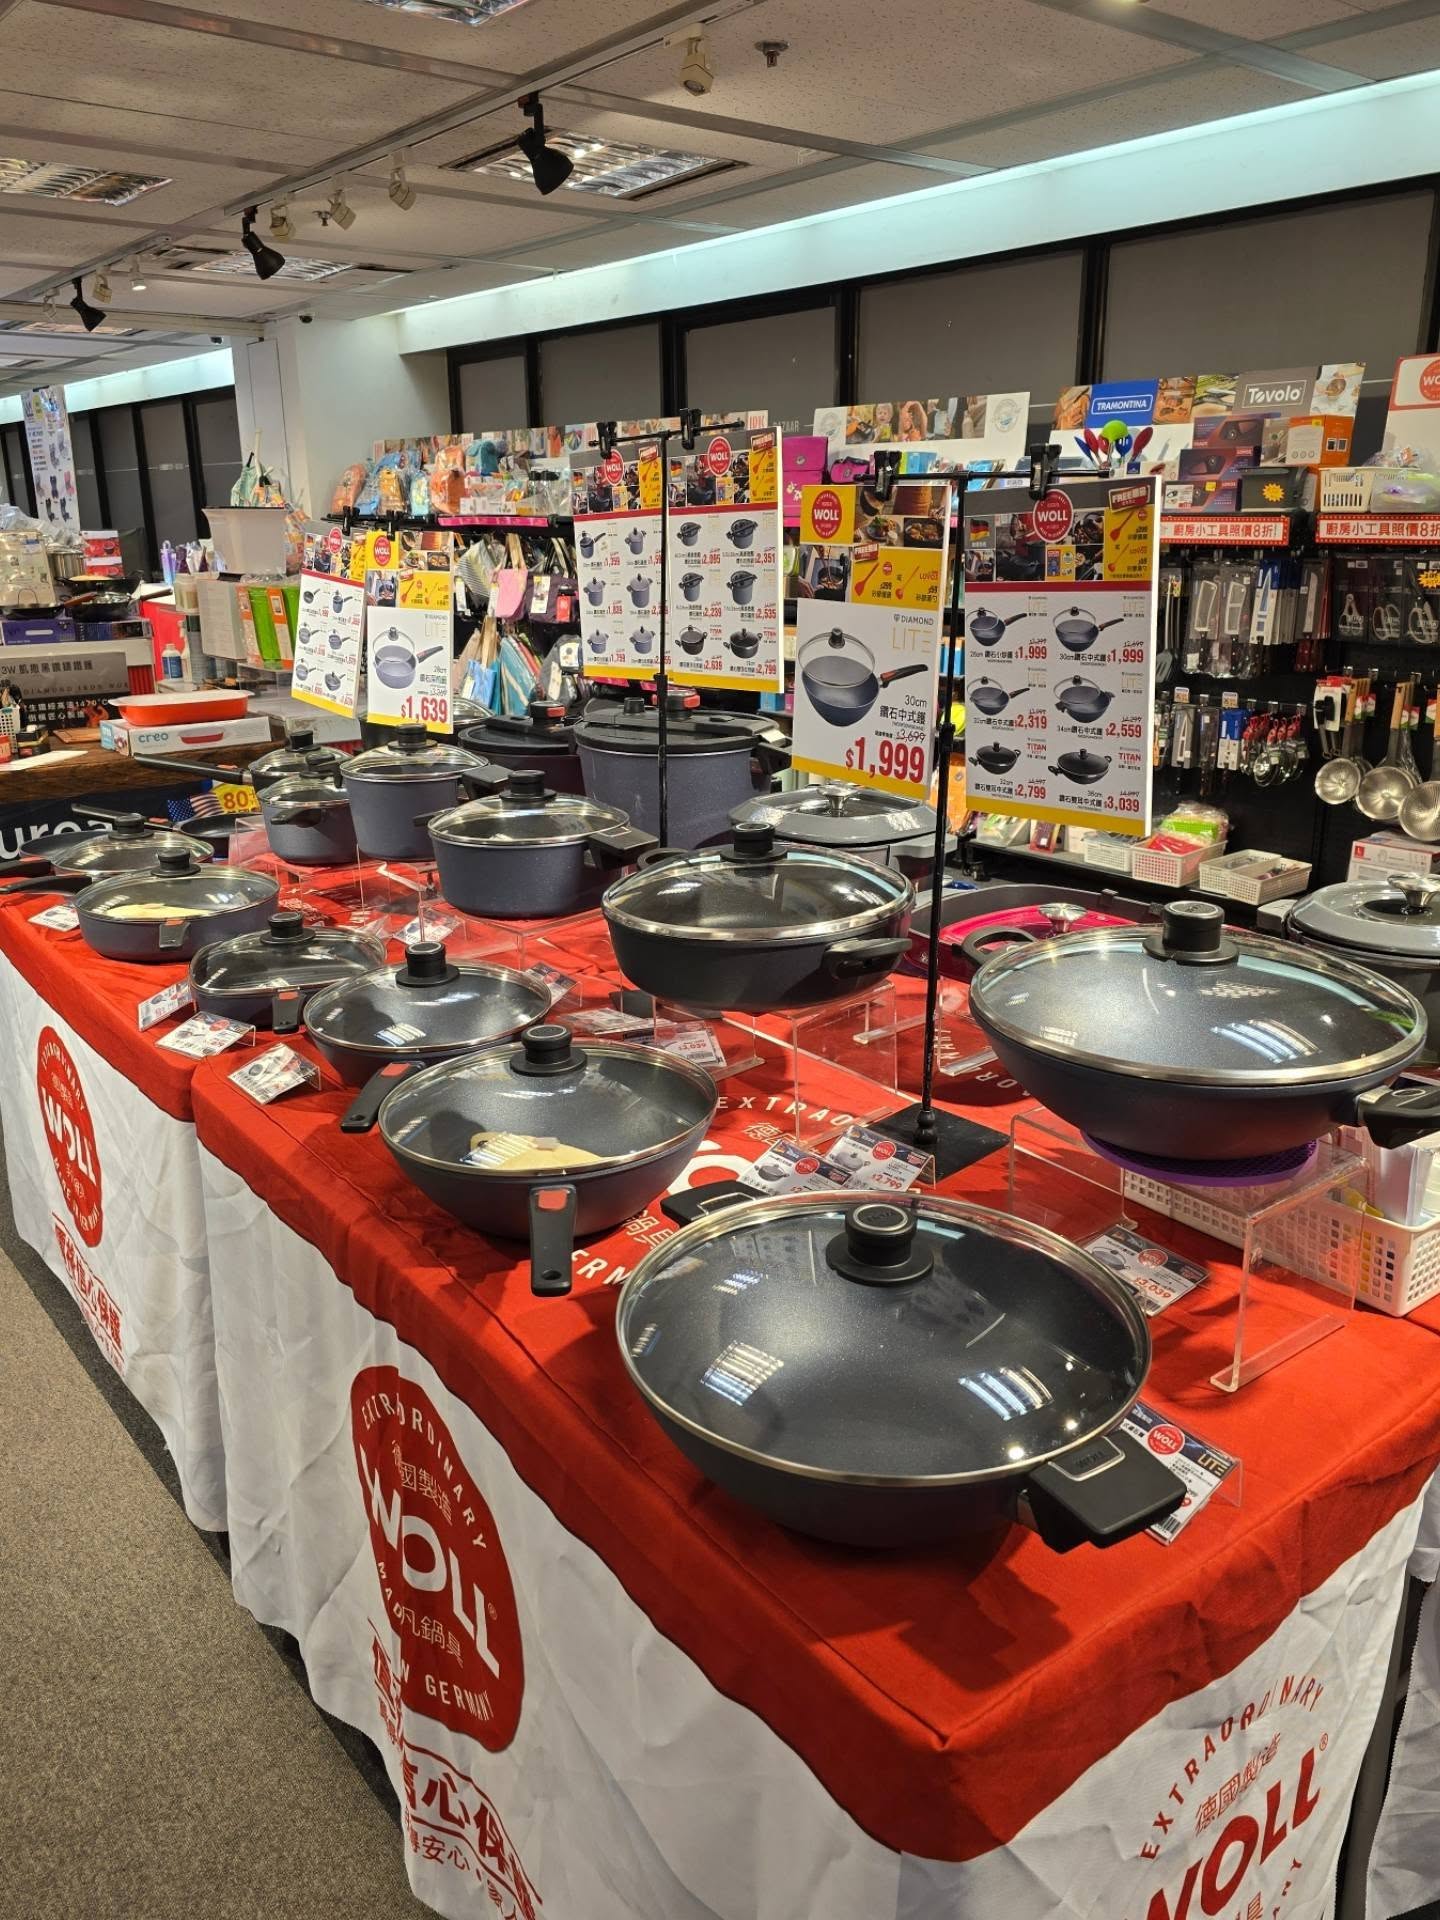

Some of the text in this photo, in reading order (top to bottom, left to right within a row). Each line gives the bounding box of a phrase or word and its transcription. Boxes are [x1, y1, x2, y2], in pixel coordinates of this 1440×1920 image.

[1249, 388, 1300, 403] Tovolo
[1097, 399, 1147, 411] TRAMONTINA
[814, 509, 838, 520] WOLL
[1037, 510, 1068, 522] WOLL
[375, 547, 390, 555] WOLL
[901, 615, 934, 626] DIAMOND
[893, 627, 932, 652] LITE
[1015, 645, 1047, 661] $1,999
[1107, 649, 1144, 664] $1,999
[401, 696, 447, 723] $1,639
[905, 695, 927, 708] 30cm
[1013, 714, 1047, 731] $2,319
[1105, 722, 1141, 738] $2,559
[138, 732, 169, 744] creo
[1027, 743, 1047, 752] TITAN
[846, 736, 925, 784] $1,999
[1119, 753, 1141, 762] TITAN
[1014, 783, 1046, 800] $2,799
[224, 790, 249, 810] 80
[1104, 795, 1140, 813] $3,039
[872, 1172, 903, 1190] $2,799
[1134, 1276, 1172, 1298] $3,039
[1152, 1429, 1179, 1450] WOLL
[1197, 1453, 1228, 1476] LITE
[359, 1443, 500, 1680] WOLL
[1140, 1675, 1324, 1861] EXTRAORDINARY
